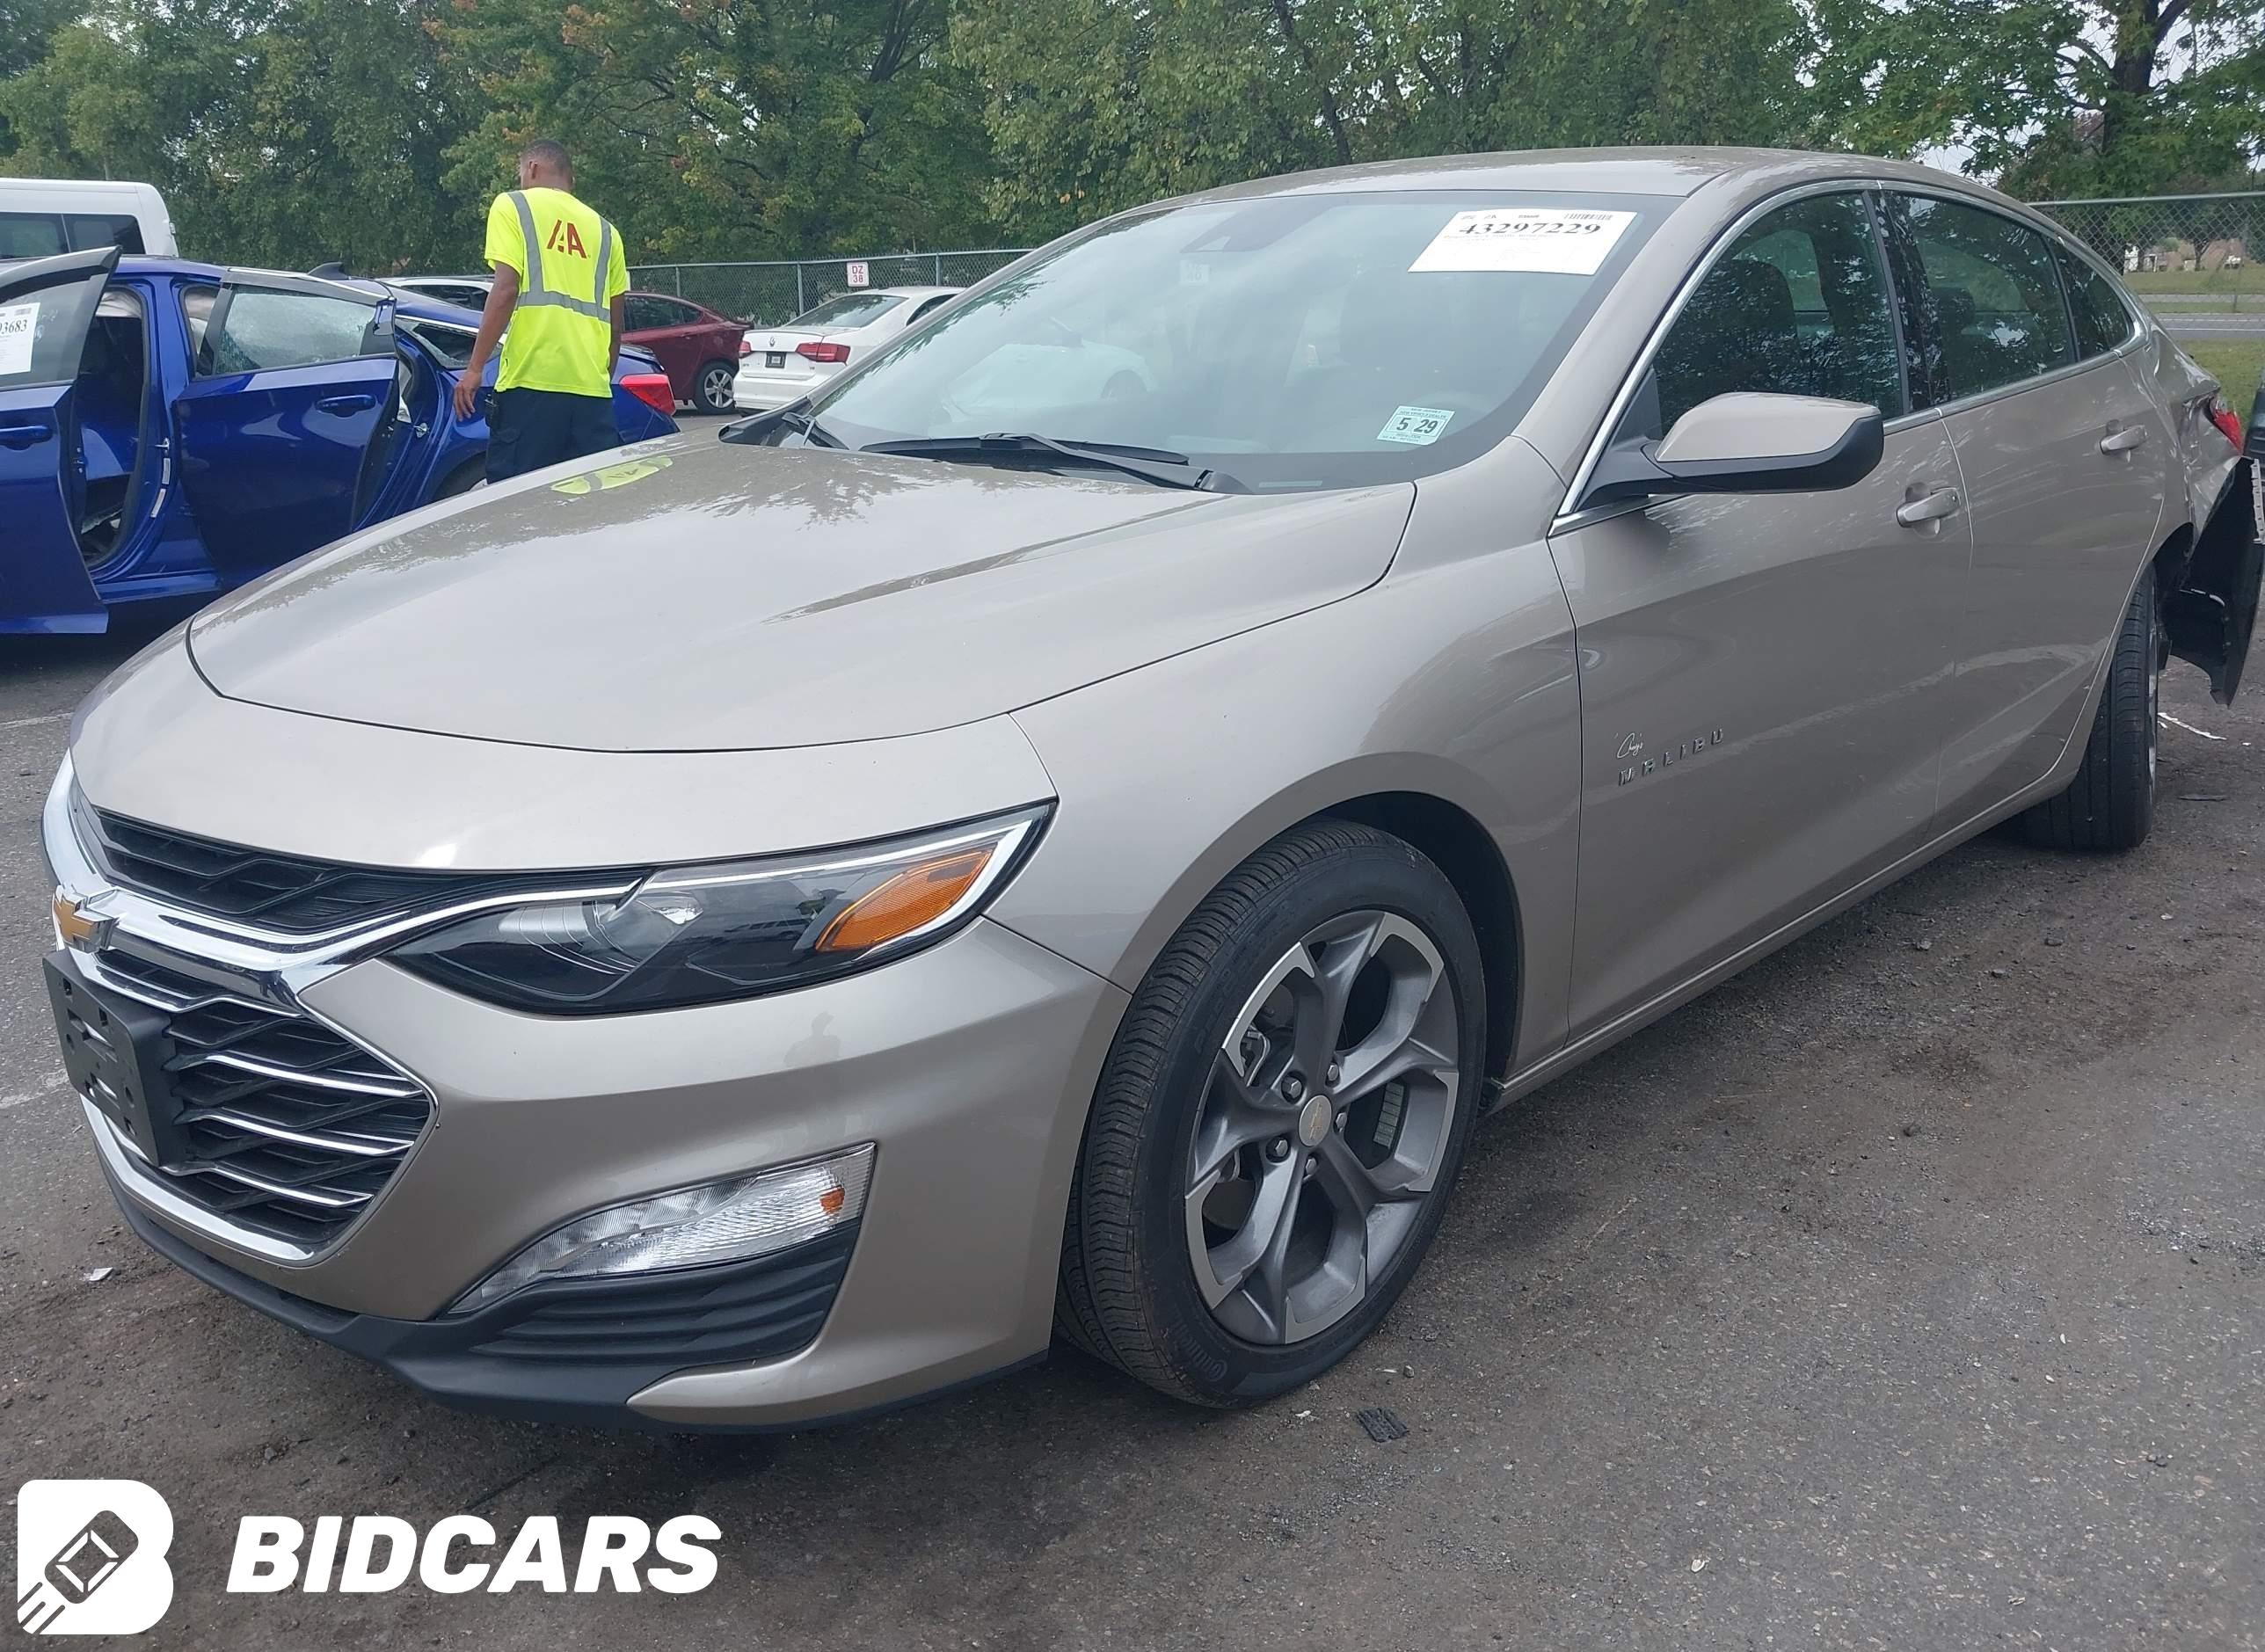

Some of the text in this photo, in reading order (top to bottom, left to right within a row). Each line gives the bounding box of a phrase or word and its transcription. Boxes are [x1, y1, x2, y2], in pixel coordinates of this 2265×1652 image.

[1459, 222, 1601, 235] 43297229
[853, 274, 863, 283] 38
[0, 319, 27, 334] 3683
[1396, 418, 1438, 433] 5 29
[1618, 728, 1723, 786] MALIBU
